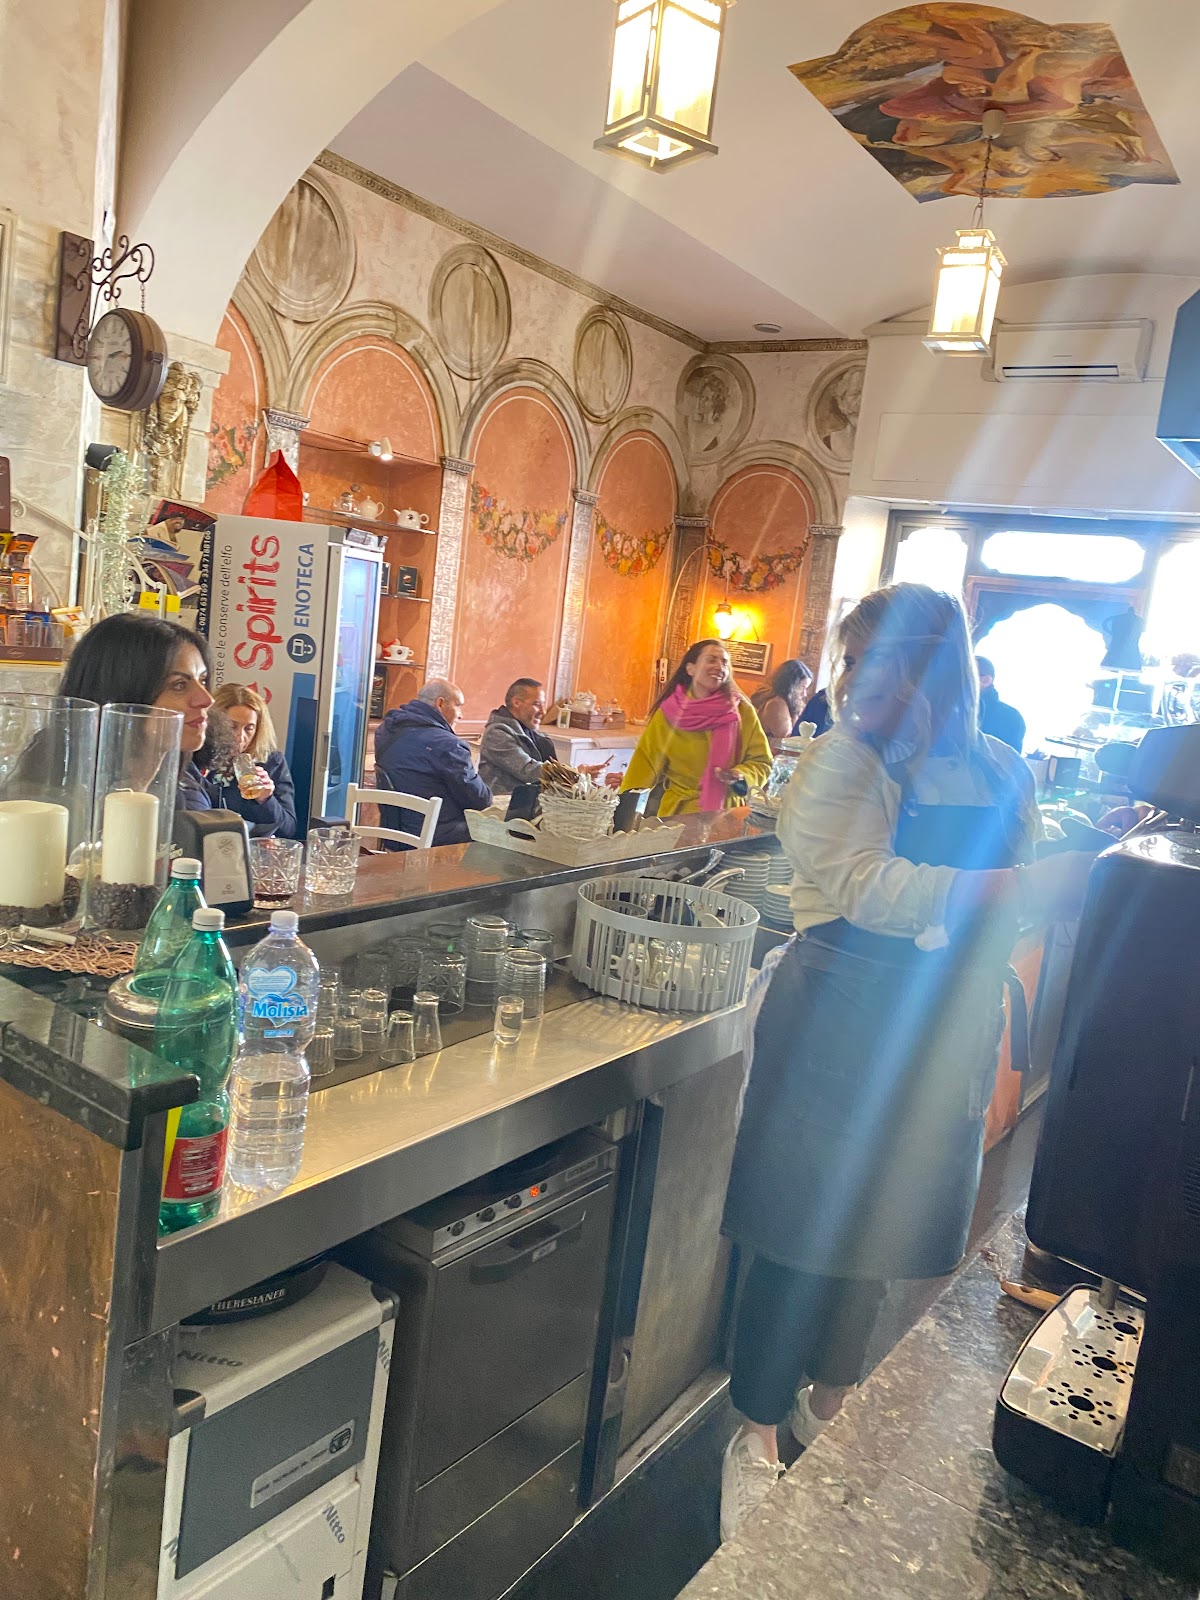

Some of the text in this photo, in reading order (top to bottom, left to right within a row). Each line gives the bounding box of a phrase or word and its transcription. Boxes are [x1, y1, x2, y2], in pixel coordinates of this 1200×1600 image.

[201, 564, 210, 578] 334
[220, 544, 233, 587] dell'elfo
[200, 583, 209, 607] 63169
[293, 543, 315, 628] ENOTECA
[218, 589, 230, 638] conserve
[233, 533, 284, 671] Spirits
[198, 608, 207, 626] 0874
[215, 640, 226, 650] le
[252, 1001, 309, 1018] Molisia
[177, 1349, 243, 1367] Nitto
[322, 1505, 346, 1544] Nitto
